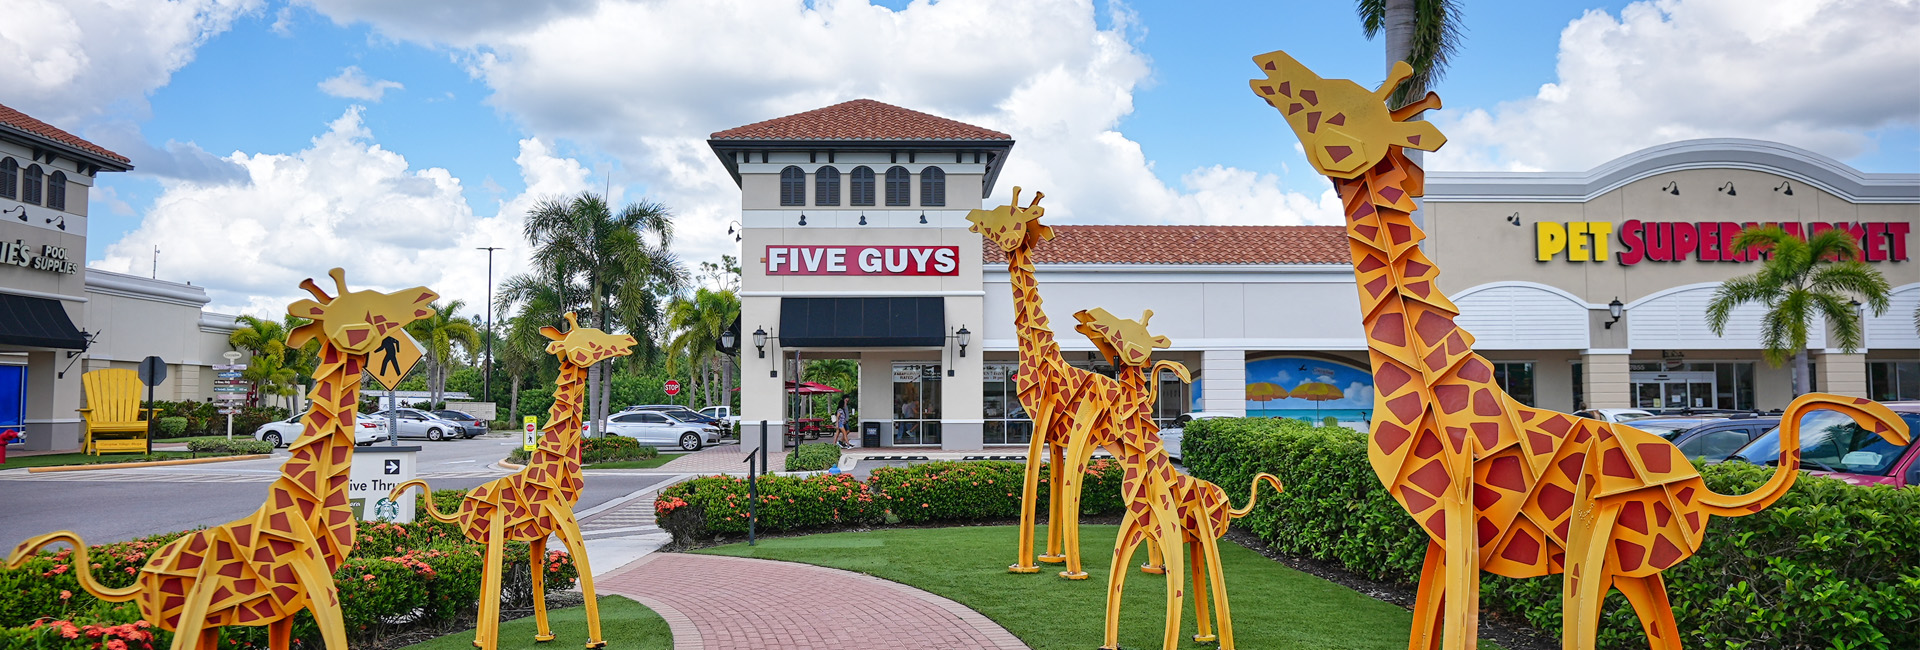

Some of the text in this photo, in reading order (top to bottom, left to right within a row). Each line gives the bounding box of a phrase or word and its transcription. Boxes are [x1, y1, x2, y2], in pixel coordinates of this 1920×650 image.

[1535, 221, 1613, 262] PET
[45, 245, 69, 260] POOL
[768, 247, 956, 273] FIVE GUYS
[34, 257, 78, 275] SUPPLIES
[349, 479, 368, 491] ive
